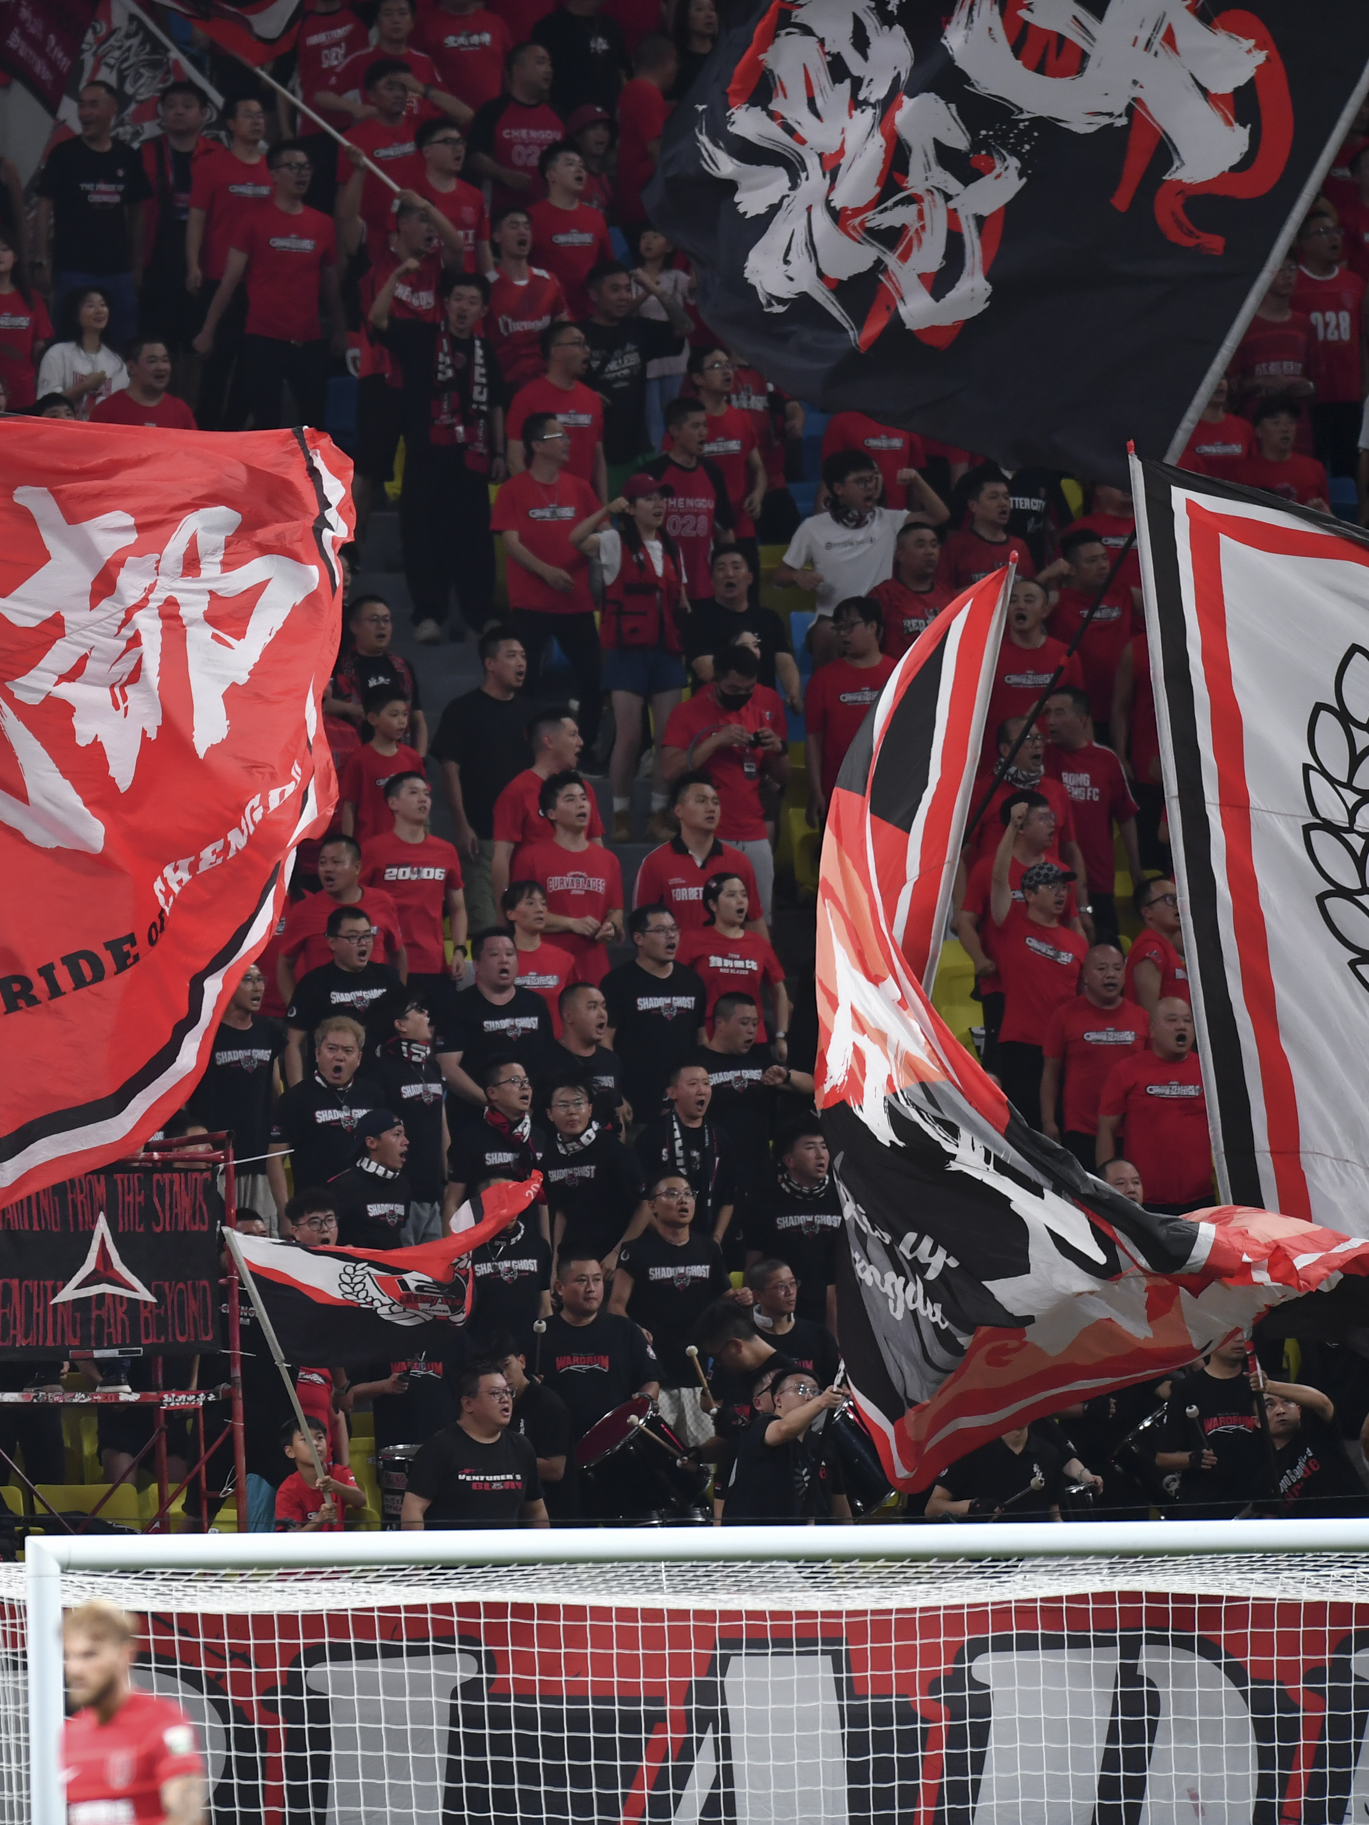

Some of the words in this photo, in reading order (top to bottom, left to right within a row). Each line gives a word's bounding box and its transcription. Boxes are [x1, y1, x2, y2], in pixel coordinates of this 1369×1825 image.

[666, 497, 714, 510] HENGDU
[636, 996, 671, 1011] SHADOW
[672, 996, 695, 1010] GHOST
[483, 1018, 515, 1032] SHADOW
[515, 1016, 538, 1030] GHOST
[215, 1049, 251, 1066] SHADOW
[741, 1069, 763, 1081] GHOST
[114, 1172, 145, 1233] THE
[152, 1171, 212, 1233] STANDS
[366, 1203, 394, 1217] SHADOW
[776, 1215, 814, 1230] SHADOW
[814, 1215, 842, 1228] GHOST
[511, 1259, 537, 1273] GHOST
[649, 1265, 685, 1281] SHADOW
[685, 1265, 710, 1278] GHOST
[90, 1292, 130, 1347] FAR
[139, 1279, 213, 1345] BEYOND
[555, 1355, 609, 1373] WARDRUM
[1203, 1415, 1255, 1435] WARDRUM
